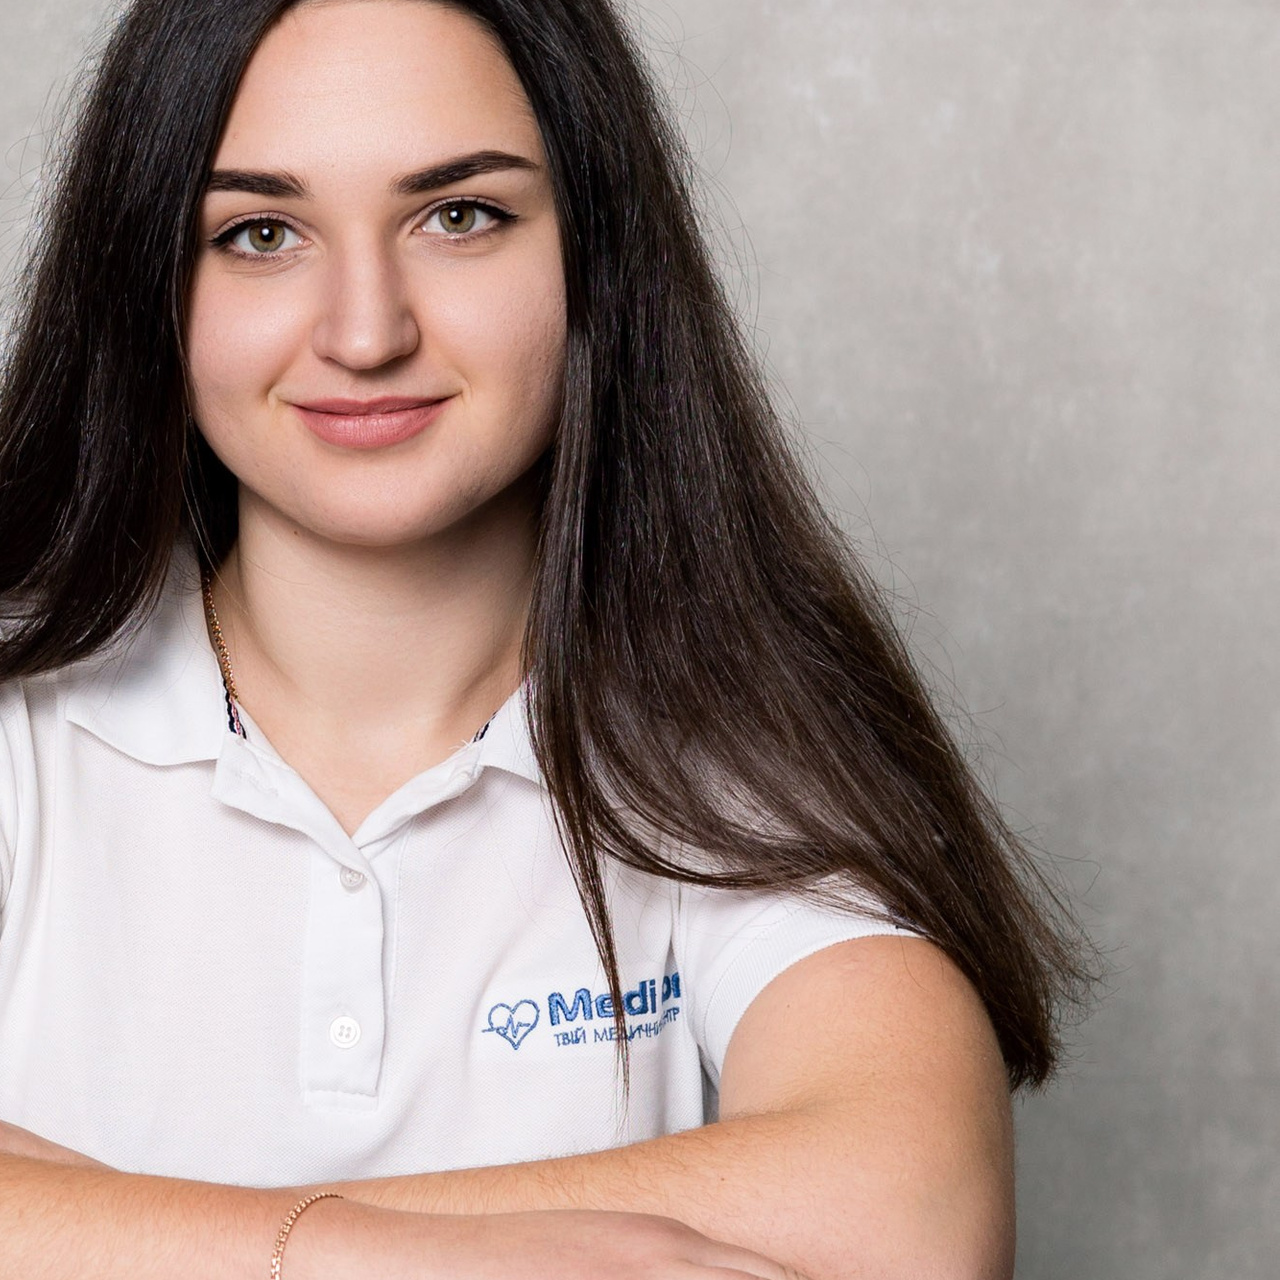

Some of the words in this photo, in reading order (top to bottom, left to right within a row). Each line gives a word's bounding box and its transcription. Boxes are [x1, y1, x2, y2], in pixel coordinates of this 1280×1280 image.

[547, 978, 656, 1026] Medi
[661, 971, 681, 1005] or
[554, 1026, 587, 1047] ТВІЙ
